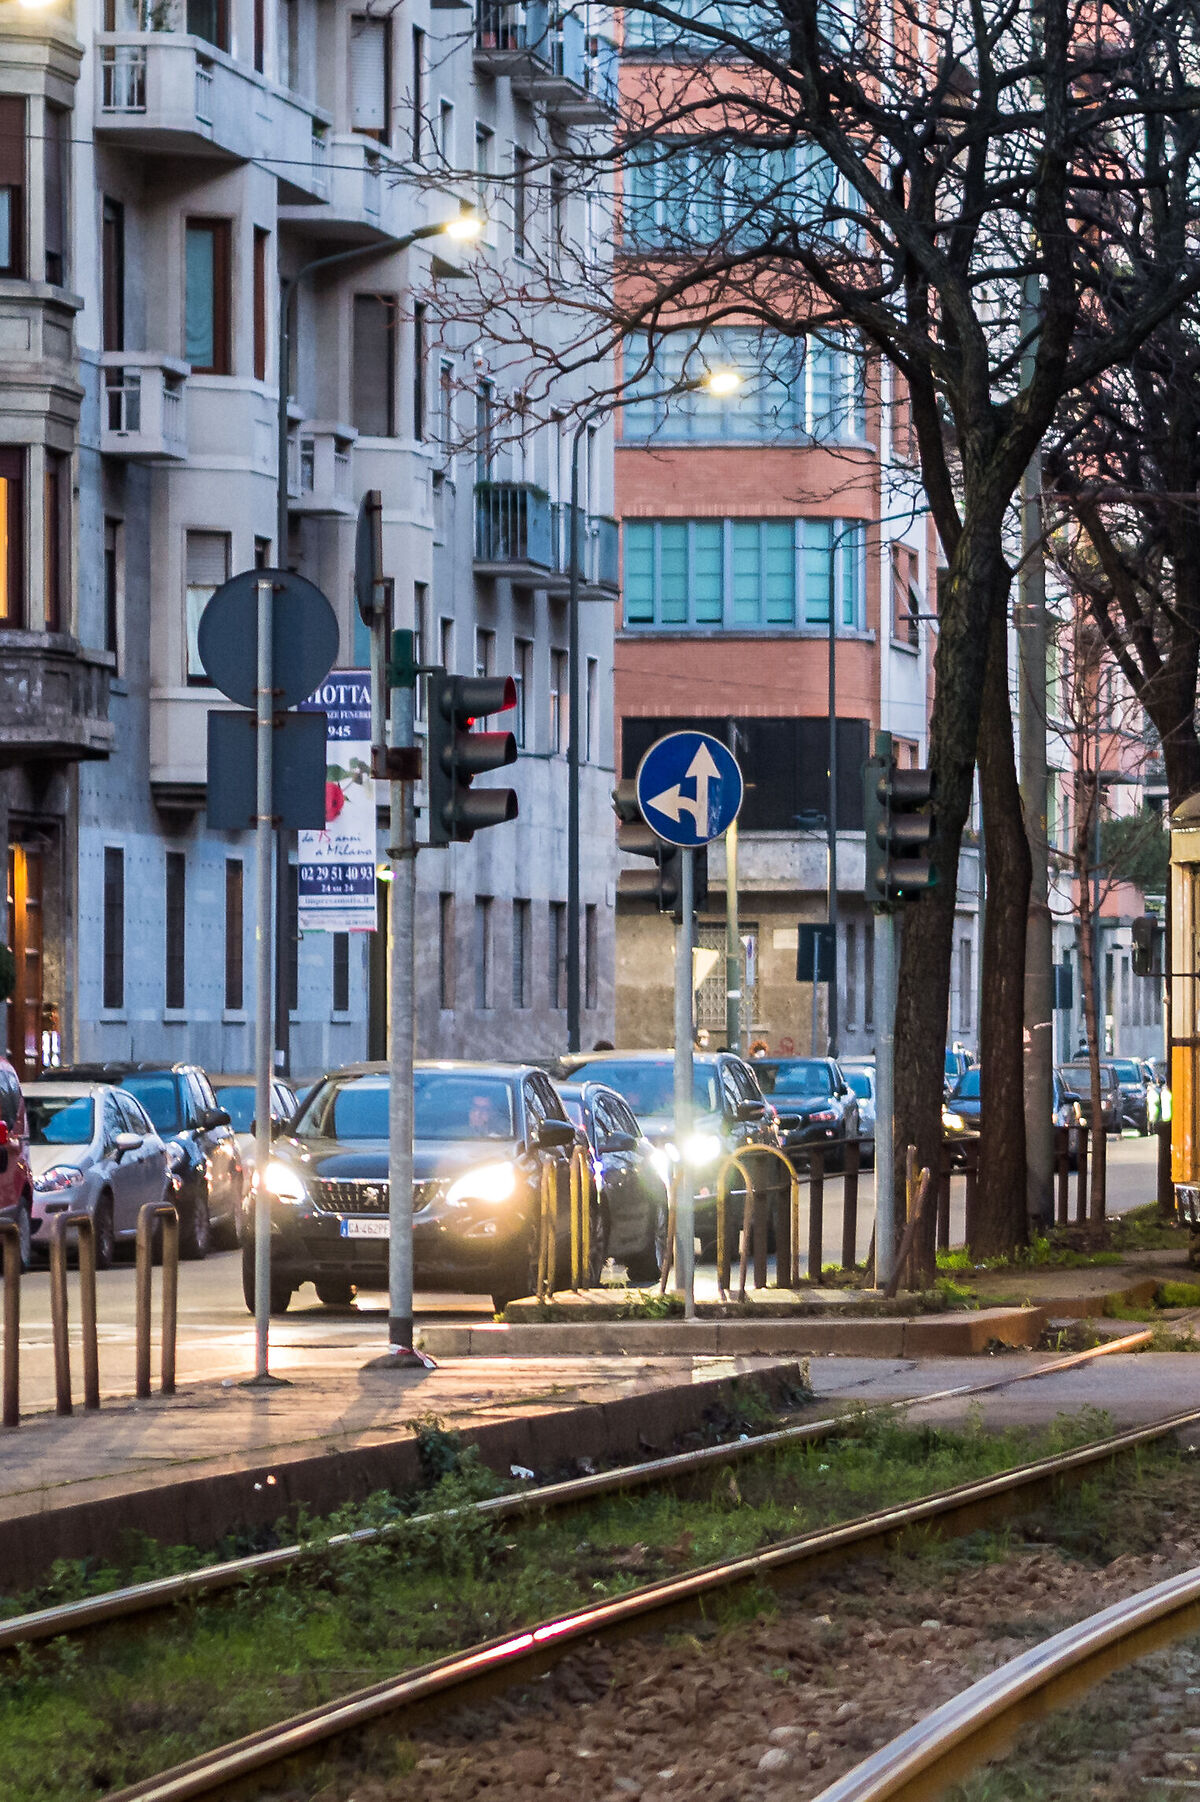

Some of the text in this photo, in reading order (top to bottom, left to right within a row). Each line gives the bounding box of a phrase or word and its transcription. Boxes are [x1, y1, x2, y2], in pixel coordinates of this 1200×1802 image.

[327, 725, 351, 737] 945
[327, 844, 372, 856] Milano
[301, 866, 373, 881] 02 29 51 40 93
